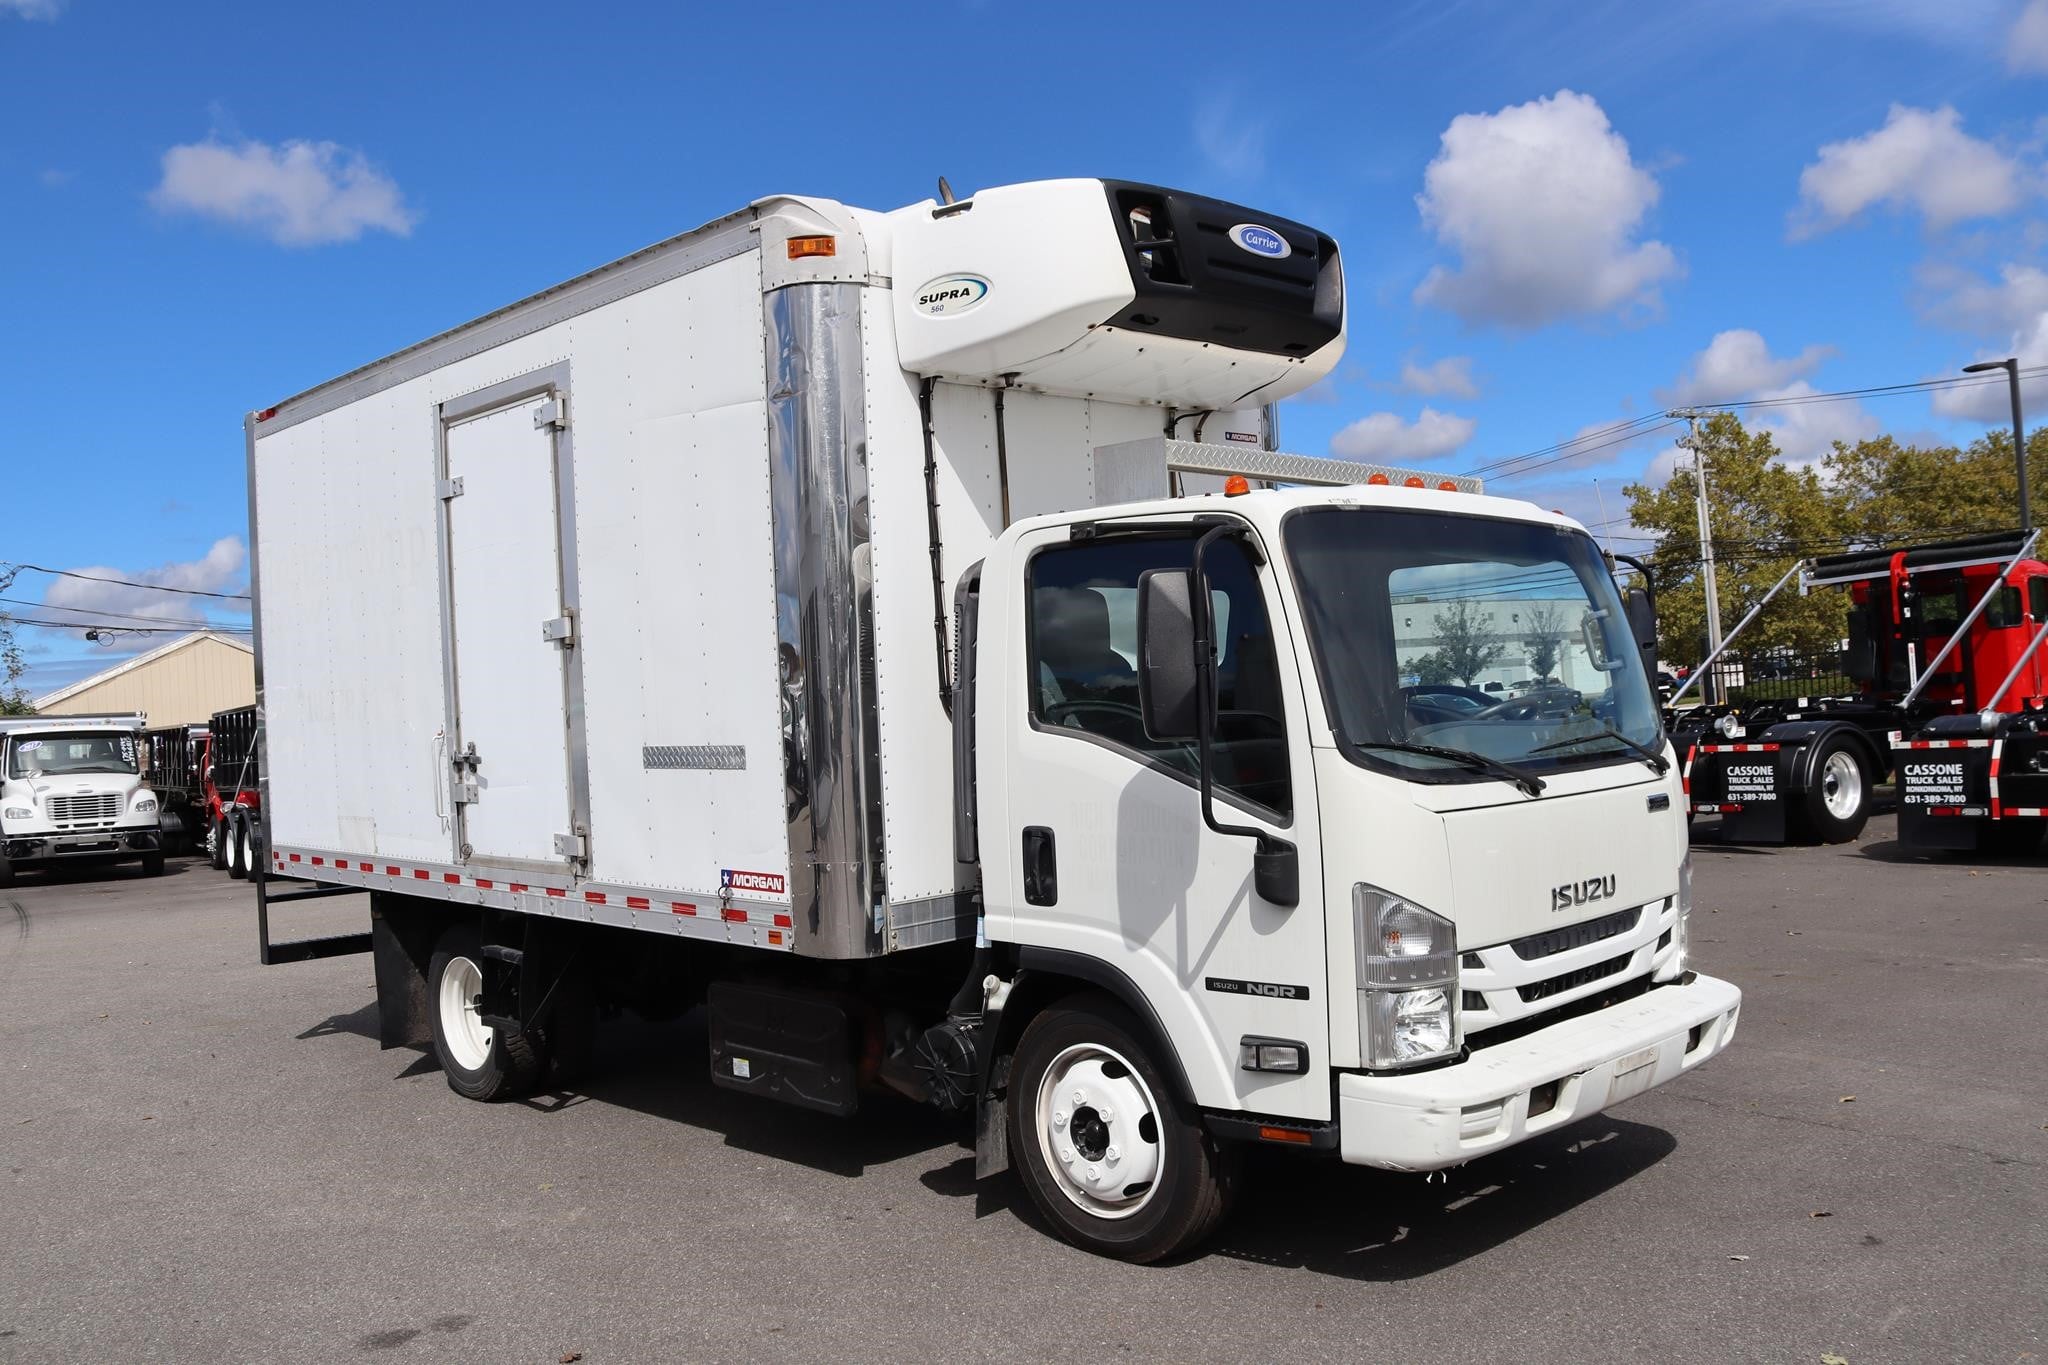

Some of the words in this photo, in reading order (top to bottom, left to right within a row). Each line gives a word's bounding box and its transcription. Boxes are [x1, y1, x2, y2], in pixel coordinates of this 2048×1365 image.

[1246, 232, 1278, 249] Carrier
[919, 287, 970, 305] SUPRA
[931, 304, 944, 313] 560
[1727, 766, 1774, 776] CASSONE
[1904, 764, 1963, 776] CASSONE
[1752, 776, 1774, 784] SALES
[1905, 776, 1934, 784] TRUCK
[1936, 776, 1964, 784] SALES
[1727, 793, 1776, 801] 631-389-7800
[1904, 794, 1967, 803] 631-389-7800
[732, 873, 782, 891] MORGAN
[1551, 873, 1616, 912] ISUZU
[1213, 982, 1238, 990] ISUZU
[1246, 983, 1296, 998] NQR
